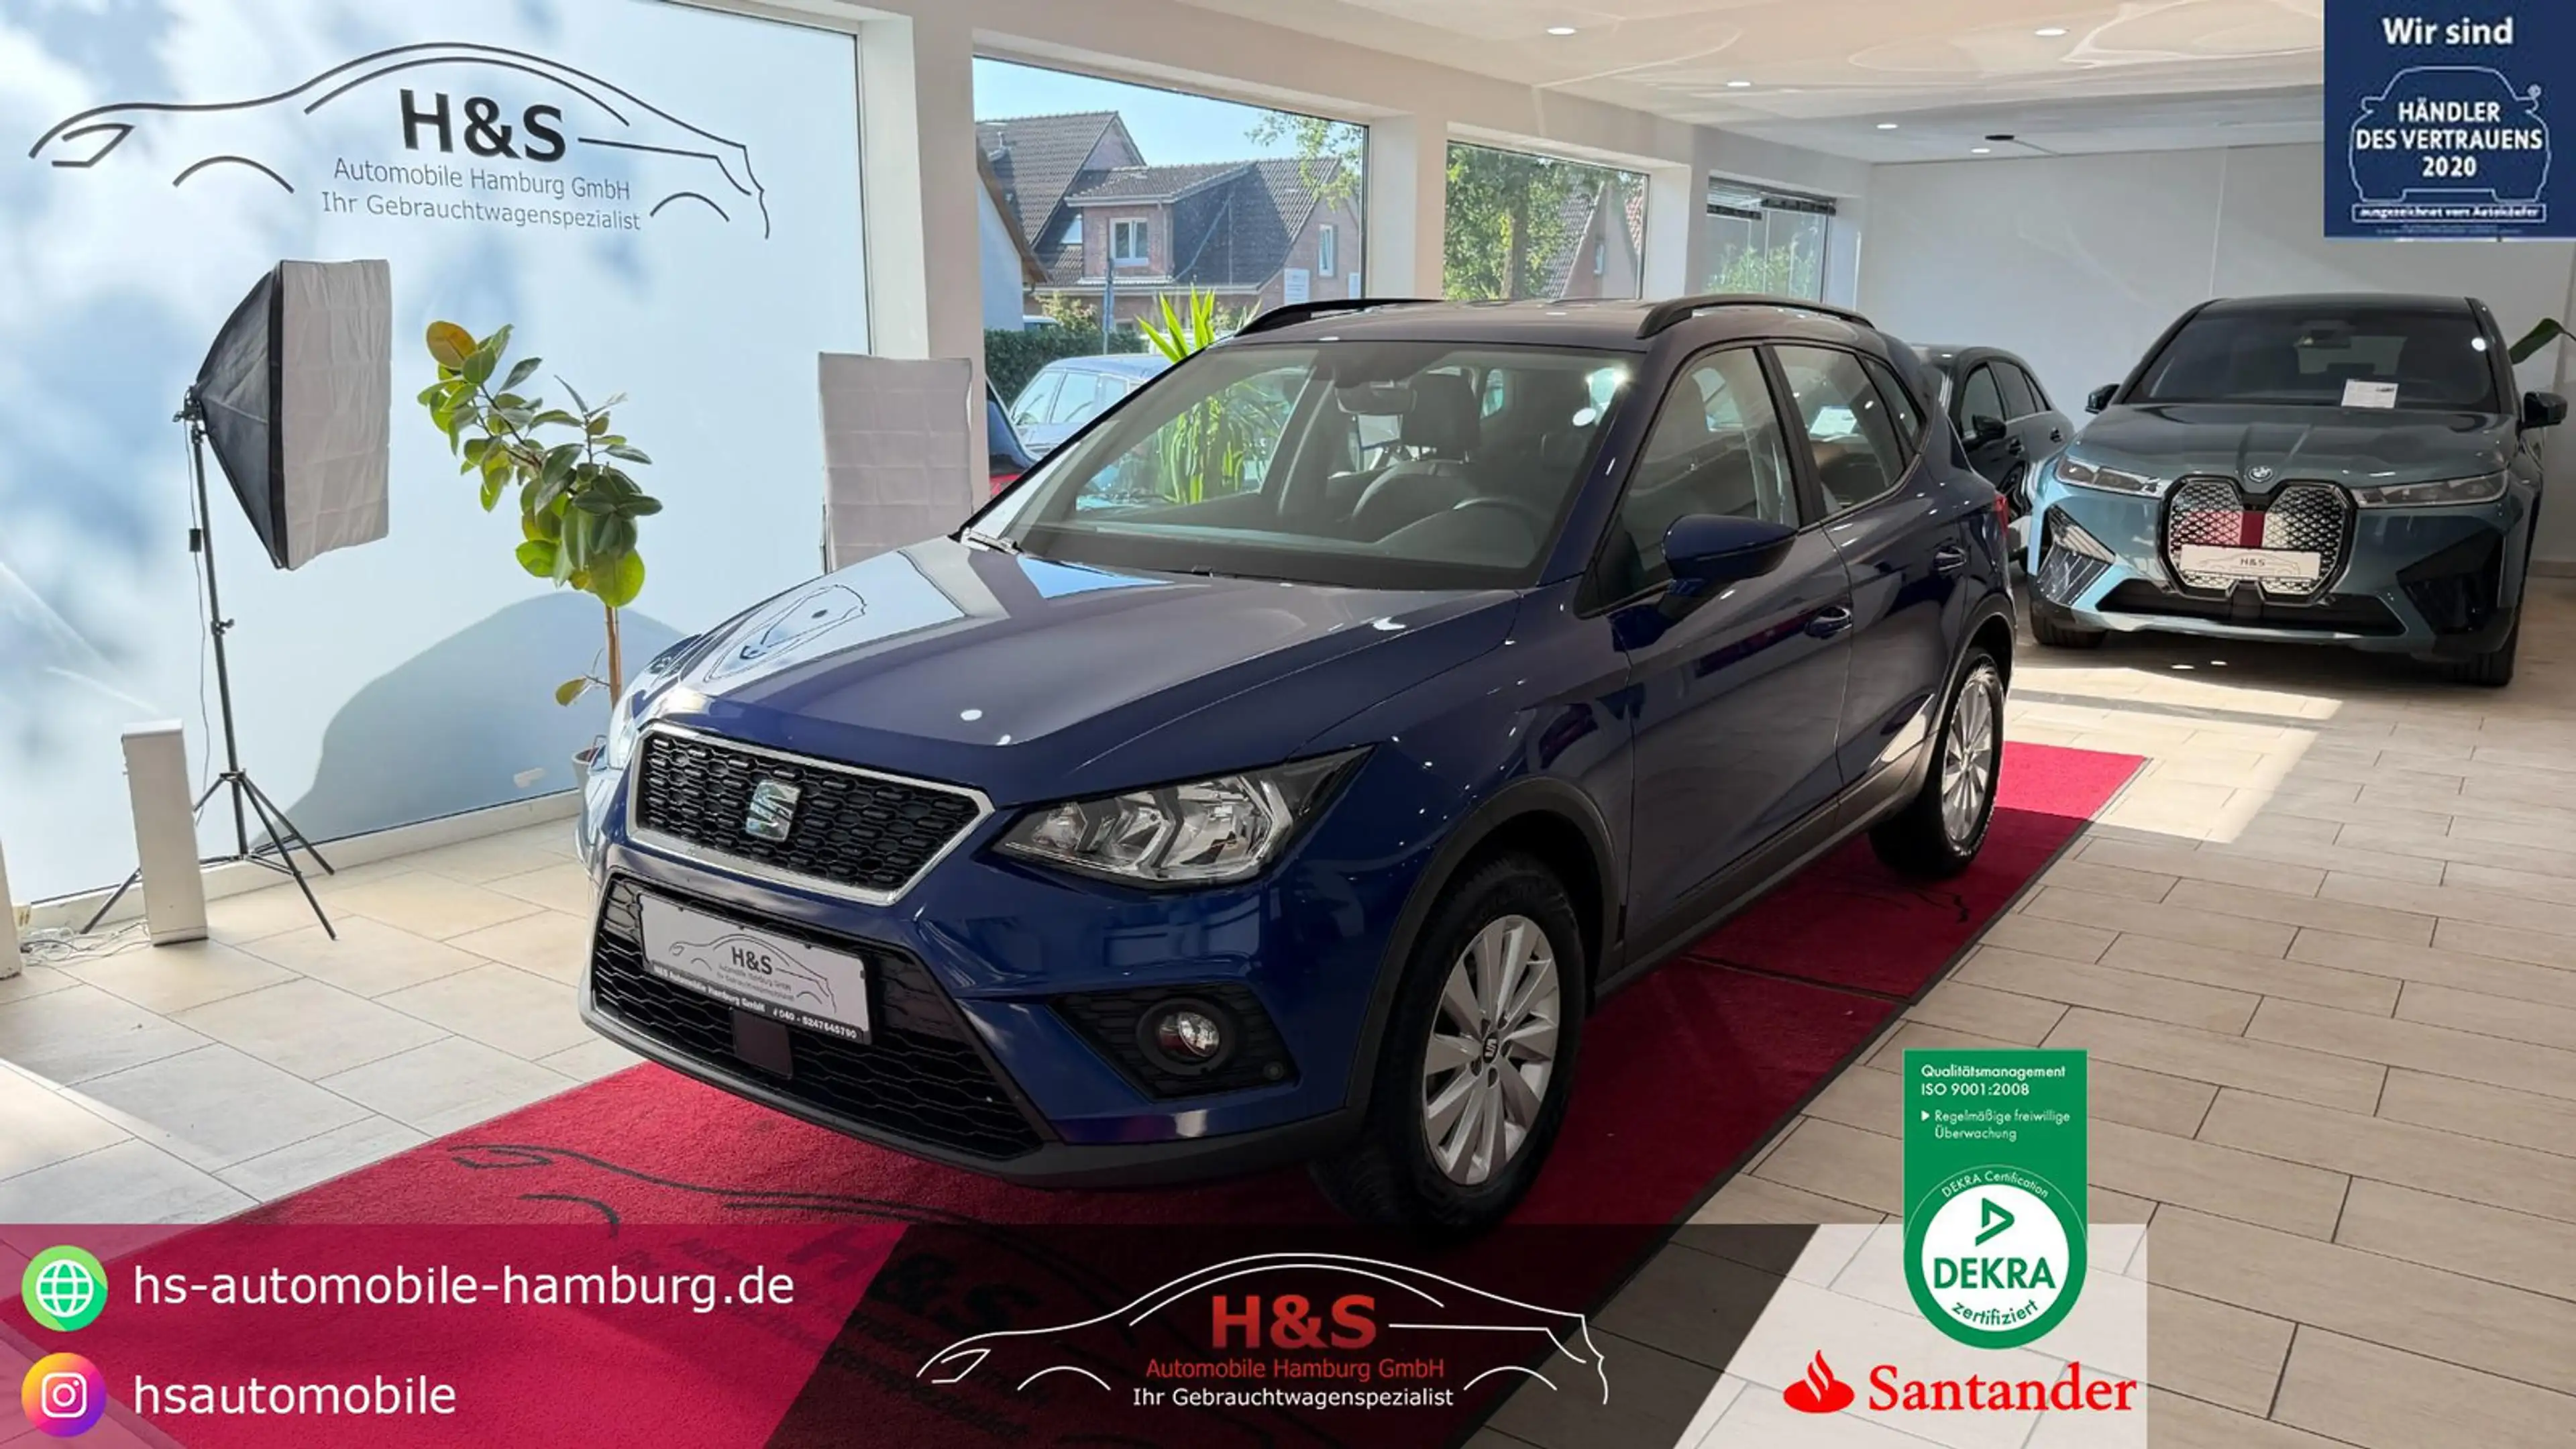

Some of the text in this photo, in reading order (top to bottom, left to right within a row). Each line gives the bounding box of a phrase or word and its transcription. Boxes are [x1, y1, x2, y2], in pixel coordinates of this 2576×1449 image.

[399, 89, 566, 162] H&S
[333, 157, 630, 201] Automobile Hamburg GmbH
[322, 191, 641, 230] Ihr Gebrauchtwagenspezialist
[731, 947, 773, 975] H&S
